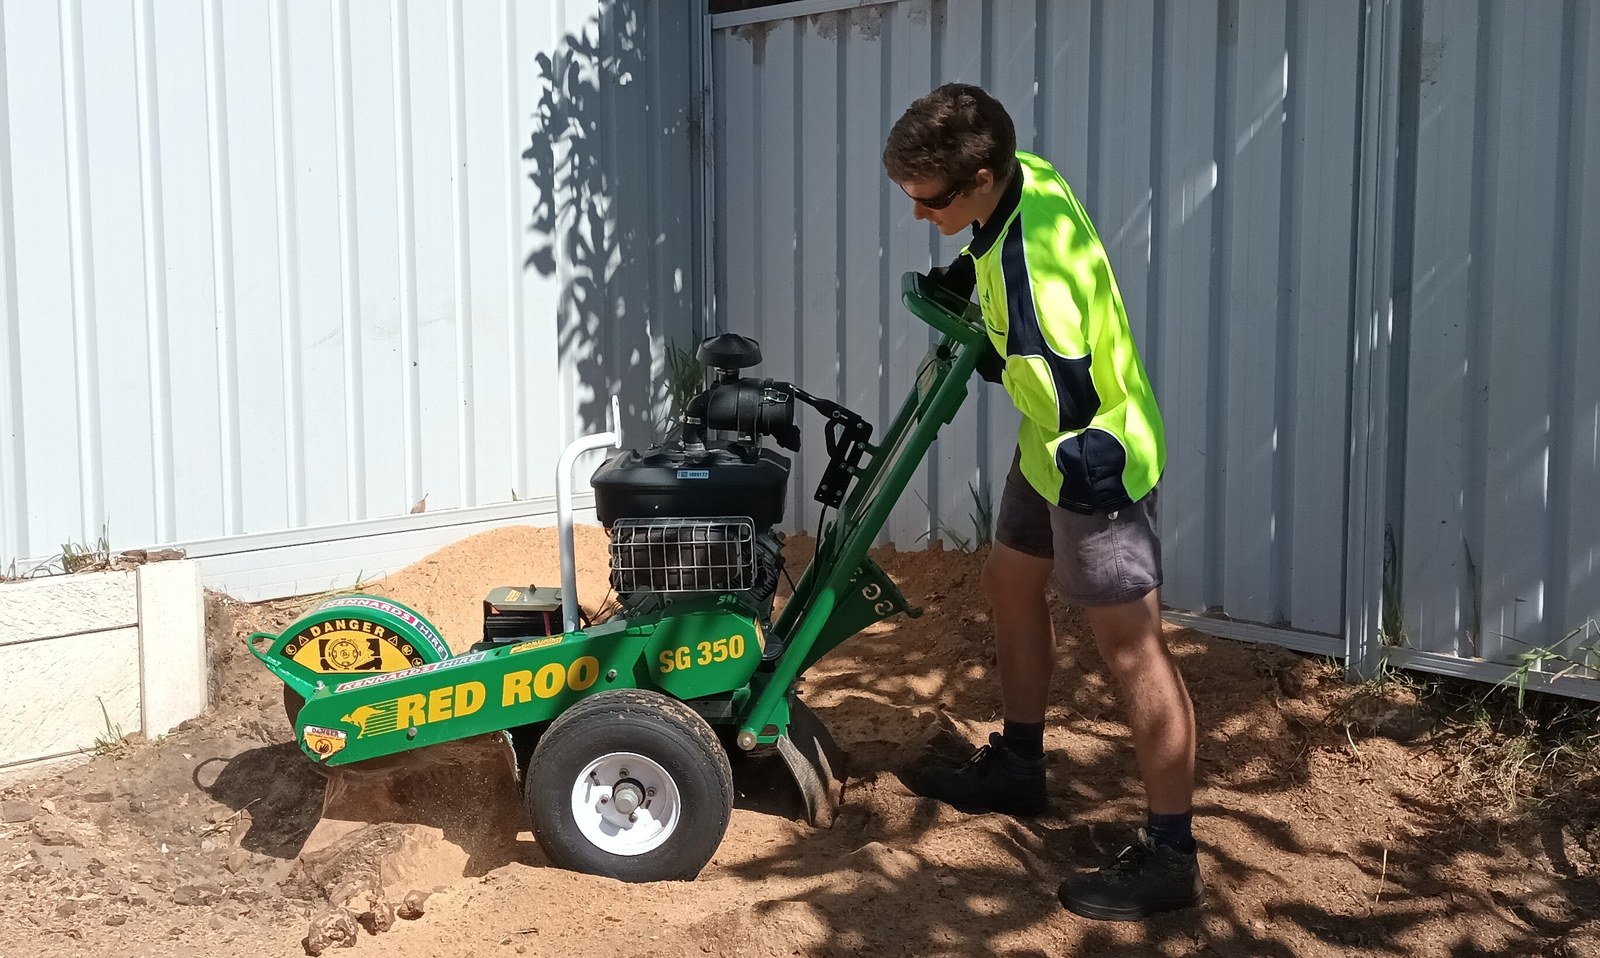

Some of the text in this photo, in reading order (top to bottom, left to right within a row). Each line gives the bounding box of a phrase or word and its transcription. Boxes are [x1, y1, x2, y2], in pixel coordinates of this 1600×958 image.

[310, 620, 385, 637] DANGER
[419, 625, 445, 654] HIRE
[659, 634, 745, 673] SG 350
[343, 656, 477, 690] KENNARDS HIRE
[396, 655, 600, 730] RED ROO
[311, 727, 339, 738] DANGER
